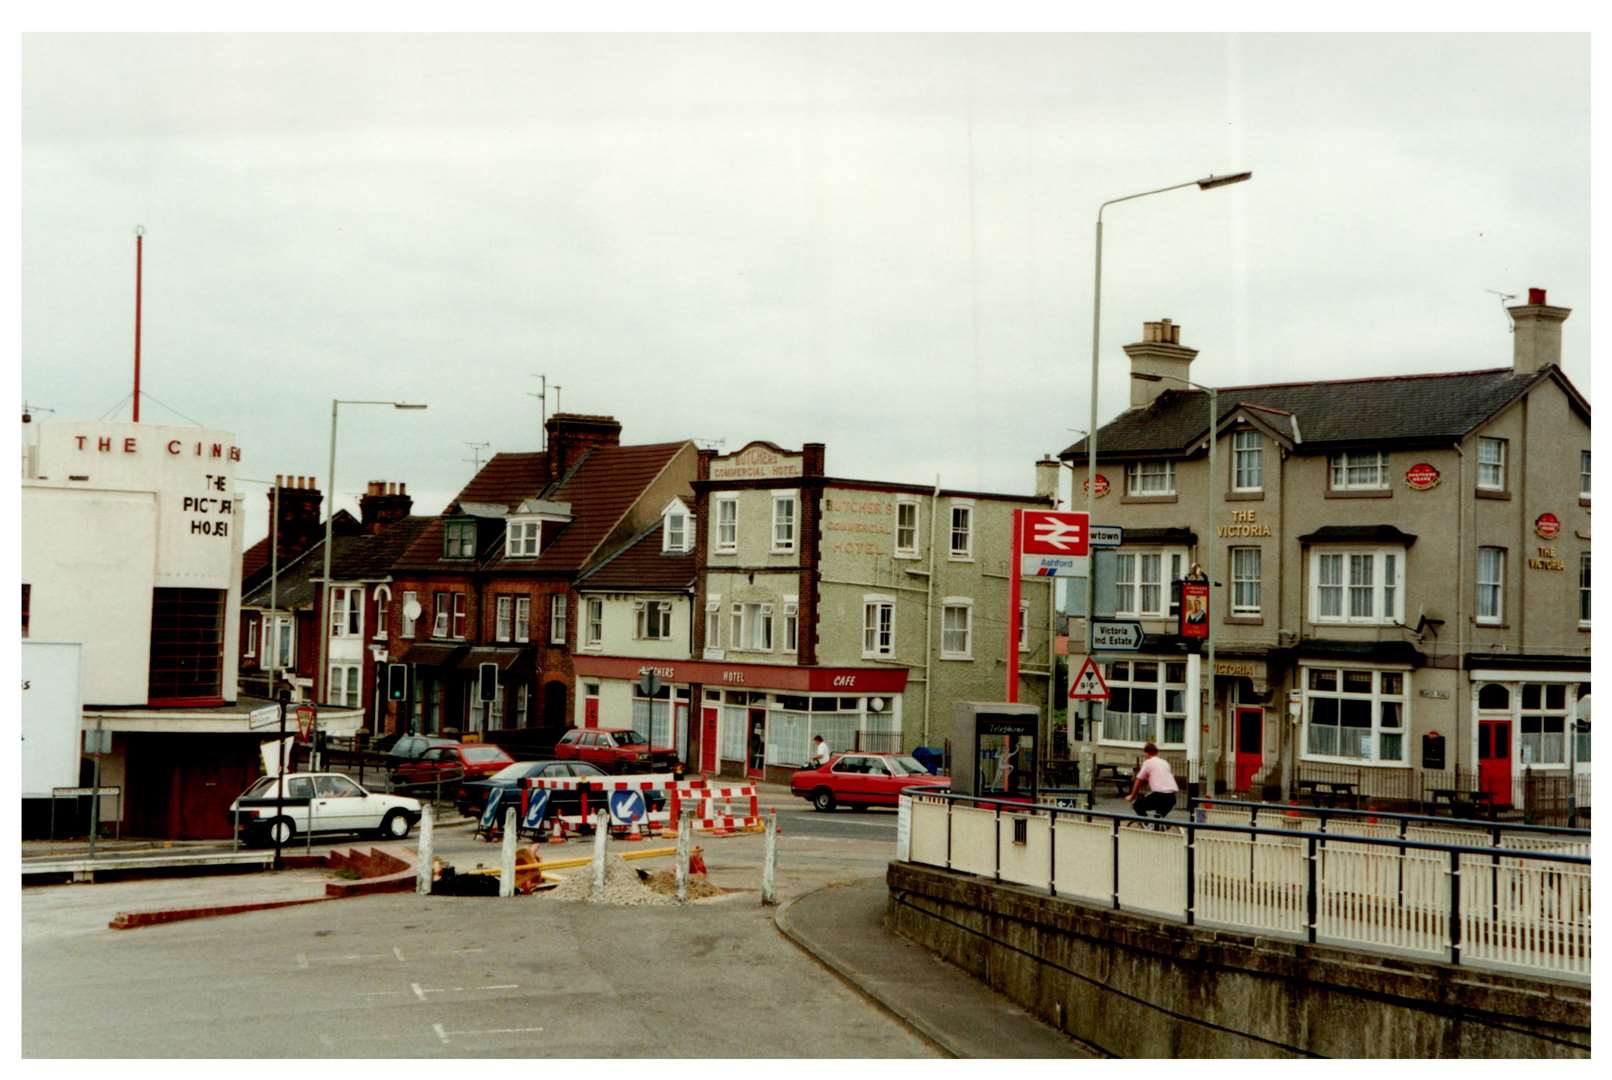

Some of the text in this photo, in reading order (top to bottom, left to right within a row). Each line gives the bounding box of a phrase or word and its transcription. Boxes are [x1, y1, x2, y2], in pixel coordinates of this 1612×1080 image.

[75, 436, 136, 453] THE
[773, 464, 800, 475] HOTEL
[206, 475, 226, 491] THE
[1232, 510, 1256, 524] THE
[1090, 531, 1119, 540] wtown
[1217, 525, 1272, 538] VICTORIA
[1538, 547, 1555, 558] THE
[1041, 559, 1073, 568] Ashford
[1528, 558, 1565, 571] VICTORIA
[1100, 626, 1127, 635] Victoria
[1110, 637, 1132, 645] Estate
[1215, 662, 1255, 676] ICTORIA
[724, 671, 744, 682] HOTEL
[833, 676, 856, 687] CAFE
